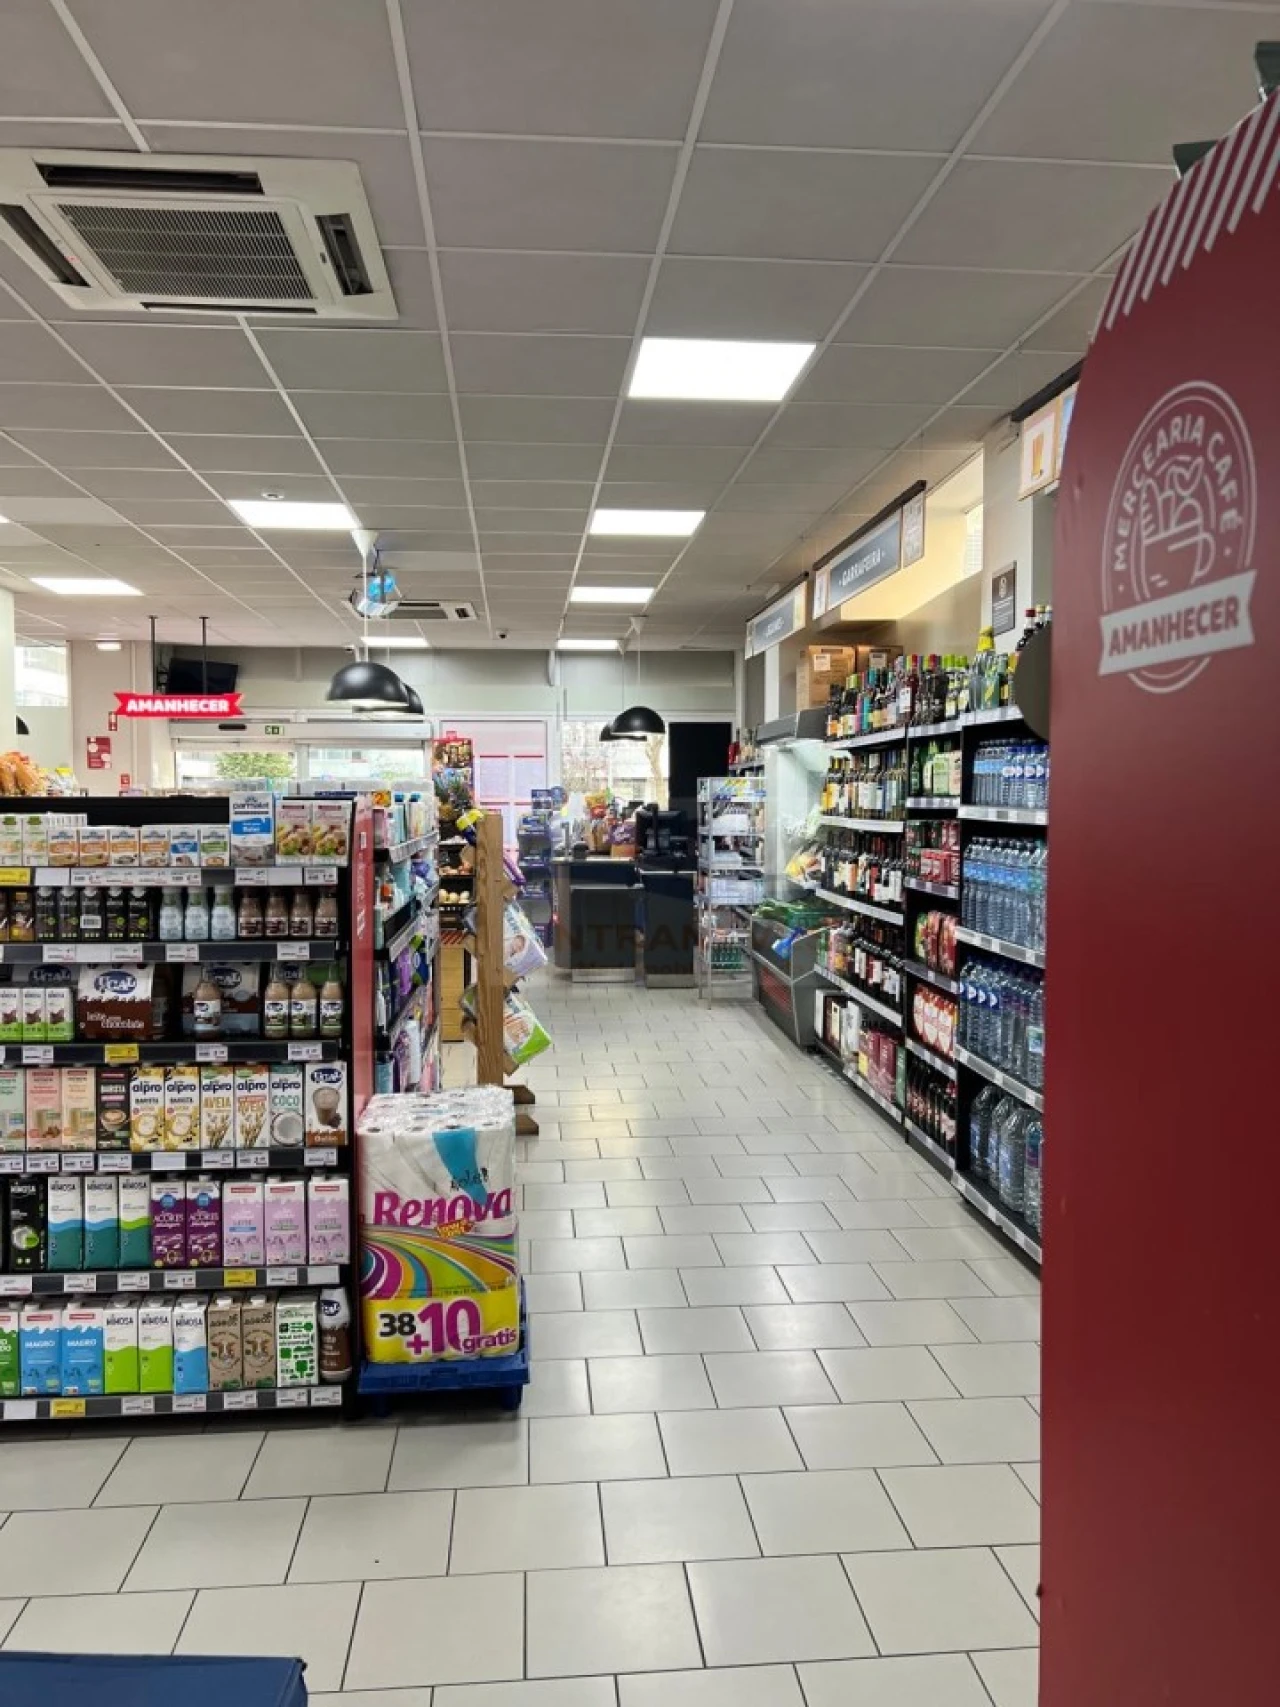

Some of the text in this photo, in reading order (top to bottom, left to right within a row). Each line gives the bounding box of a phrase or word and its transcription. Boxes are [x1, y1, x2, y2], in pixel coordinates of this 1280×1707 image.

[1113, 413, 1244, 573] MERCEARIA CAFÉ
[1108, 595, 1240, 657] AMANHECER
[126, 698, 229, 713] AMANHECER
[101, 1018, 145, 1029] chocolate
[132, 1081, 162, 1095] alpro
[167, 1081, 196, 1094] alpro
[202, 1081, 232, 1094] alpro
[237, 1079, 267, 1093] alpro
[271, 1078, 301, 1092] alpro
[271, 1094, 299, 1106] COCO
[373, 1189, 512, 1228] Renova
[106, 1313, 134, 1326] MIMOSA
[141, 1313, 169, 1326] MIMOSA
[175, 1315, 203, 1327] MIMOSA
[379, 1312, 417, 1338] 38
[462, 1326, 517, 1354] gratis
[24, 1340, 56, 1349] MAGRO
[66, 1338, 97, 1347] MAGRO
